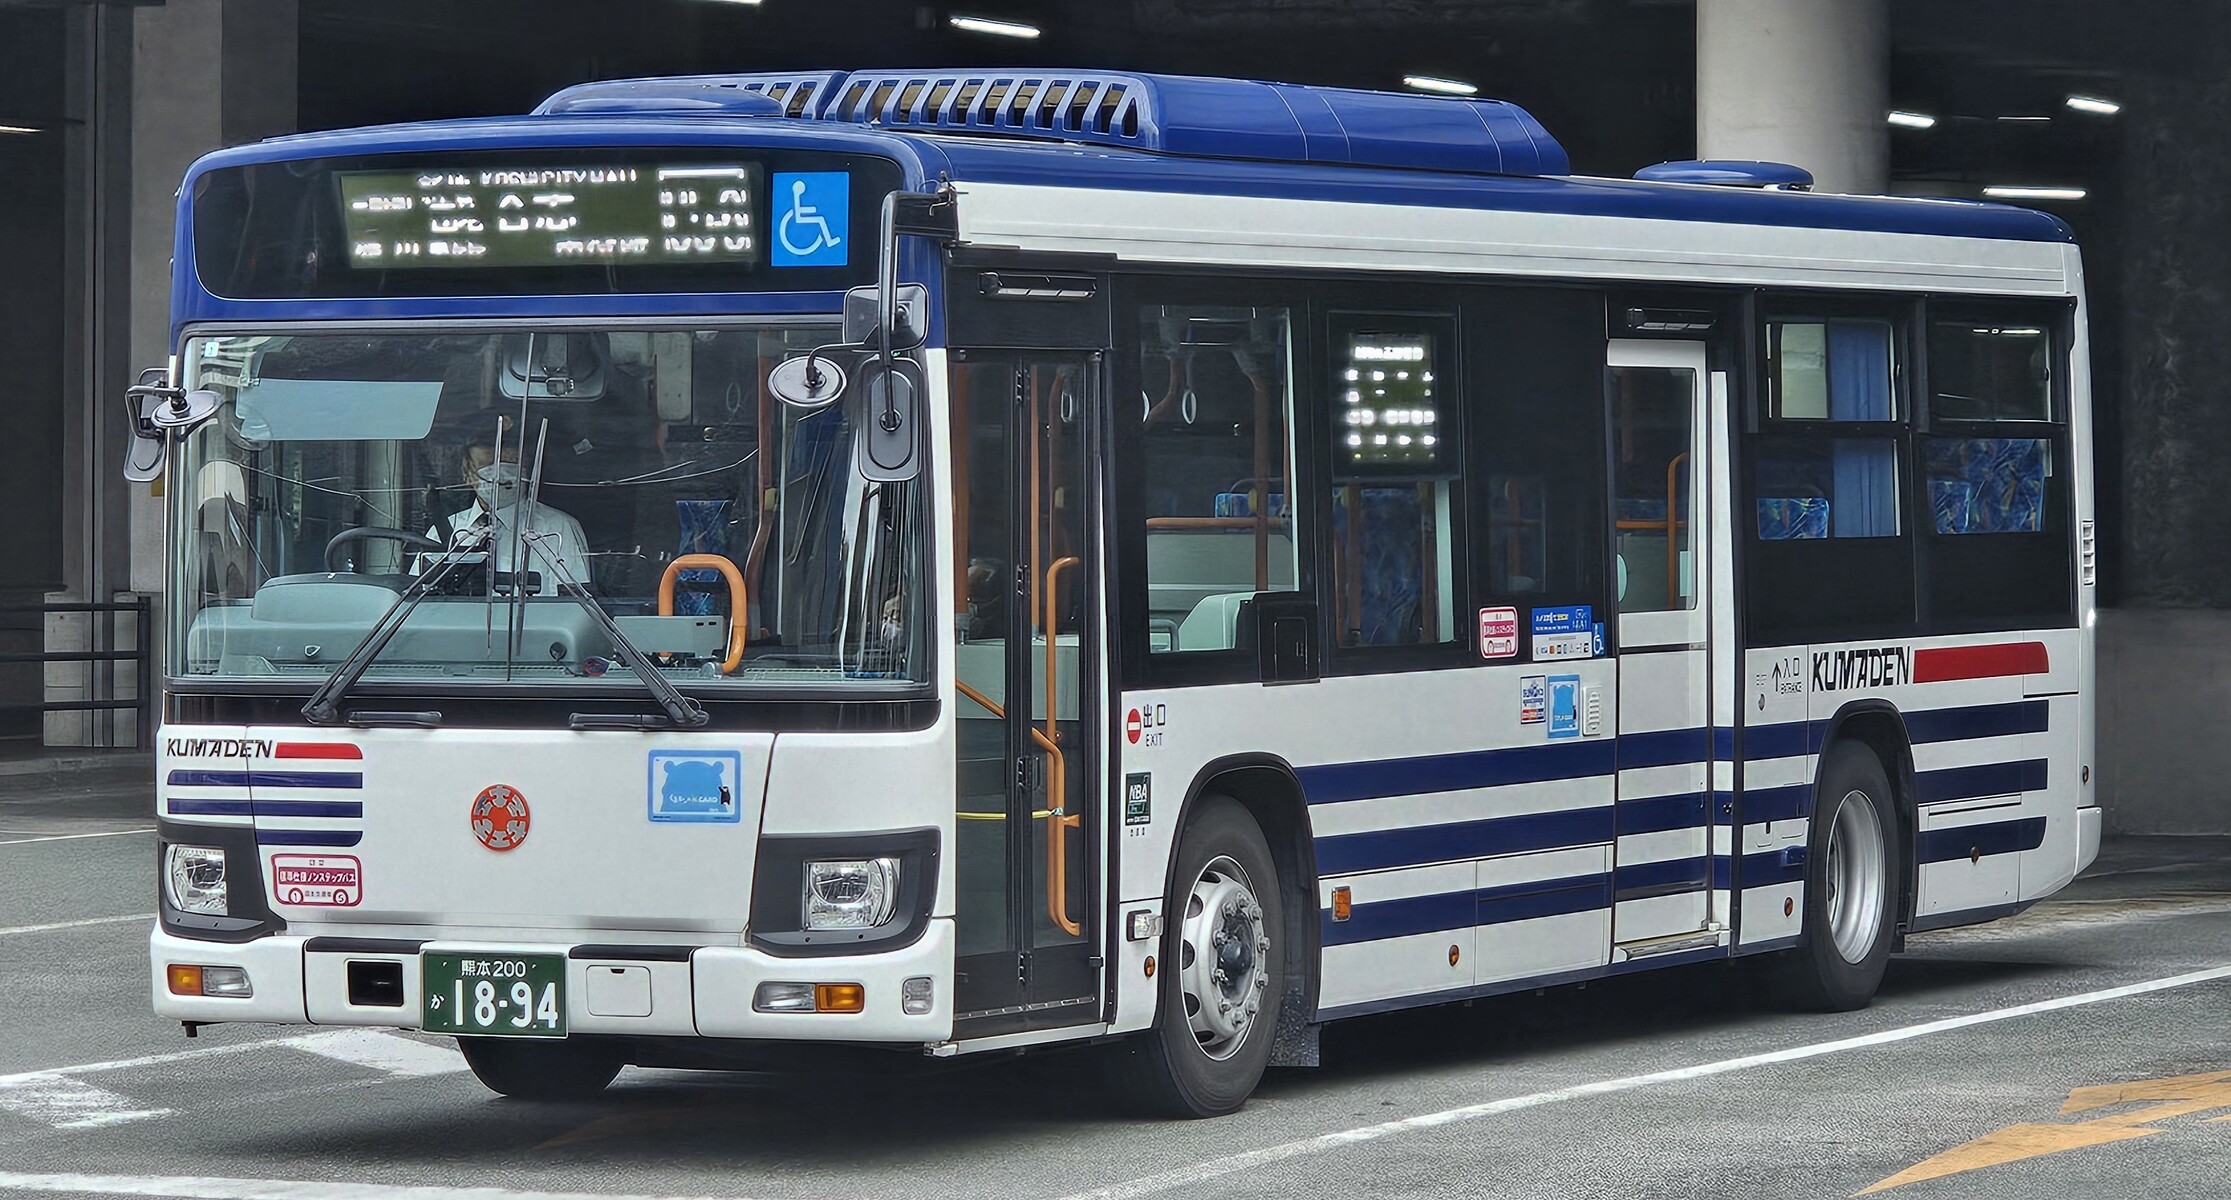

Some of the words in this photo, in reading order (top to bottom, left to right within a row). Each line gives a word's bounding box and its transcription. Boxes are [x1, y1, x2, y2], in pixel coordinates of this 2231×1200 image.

[1783, 657, 1800, 678] 入口
[1812, 646, 1910, 692] KUMADEN
[1143, 703, 1166, 728] 出口
[166, 738, 272, 758] KUMADEN
[1146, 732, 1163, 747] EXIT
[430, 993, 445, 1010] か
[455, 979, 559, 1029] 18-94
